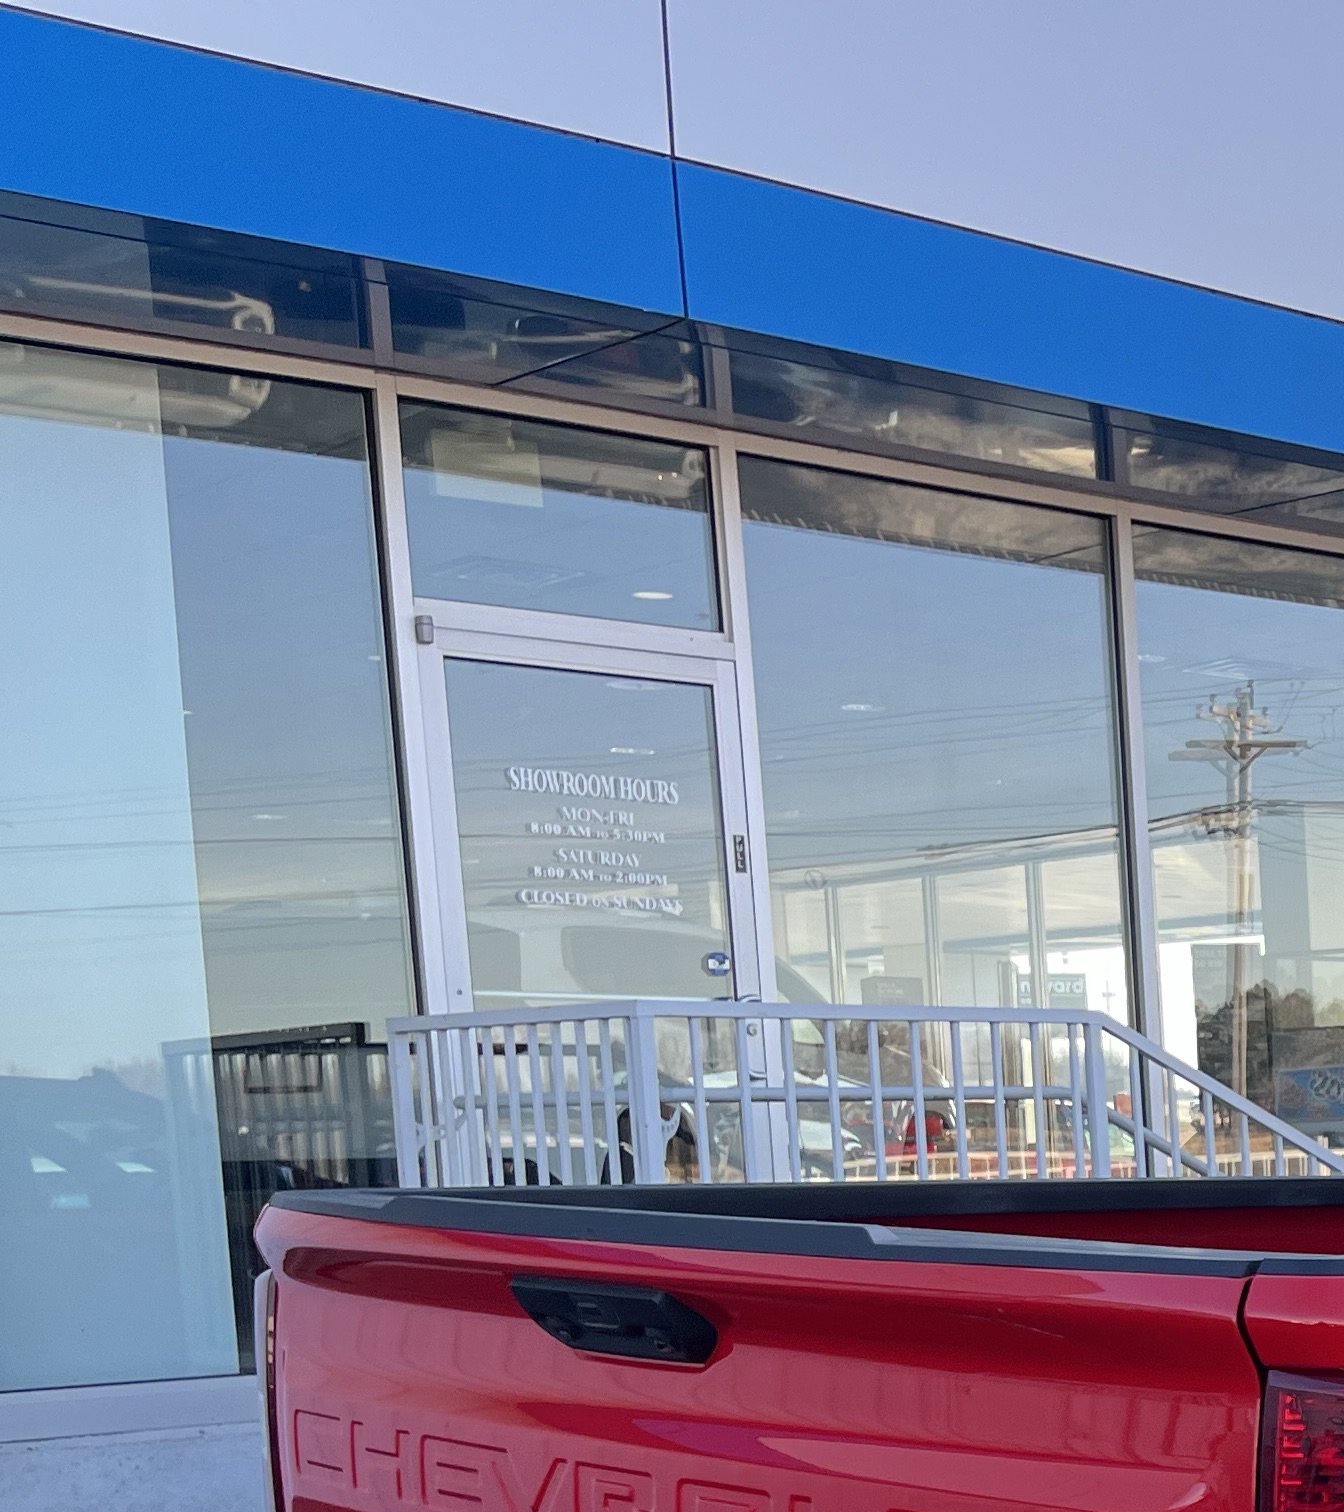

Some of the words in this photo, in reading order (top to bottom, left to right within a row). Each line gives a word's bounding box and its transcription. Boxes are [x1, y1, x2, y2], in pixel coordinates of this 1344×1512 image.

[508, 766, 616, 799] SHOWROOM
[618, 777, 680, 805] HOURS
[560, 806, 635, 827] MON-FRI
[531, 822, 562, 836] 8:00
[565, 825, 591, 838] AM
[557, 848, 642, 868] SATURDAY
[735, 836, 745, 869] PULL
[533, 865, 565, 879] 8:00
[568, 868, 594, 881] AM
[520, 889, 588, 906] CLOSED
